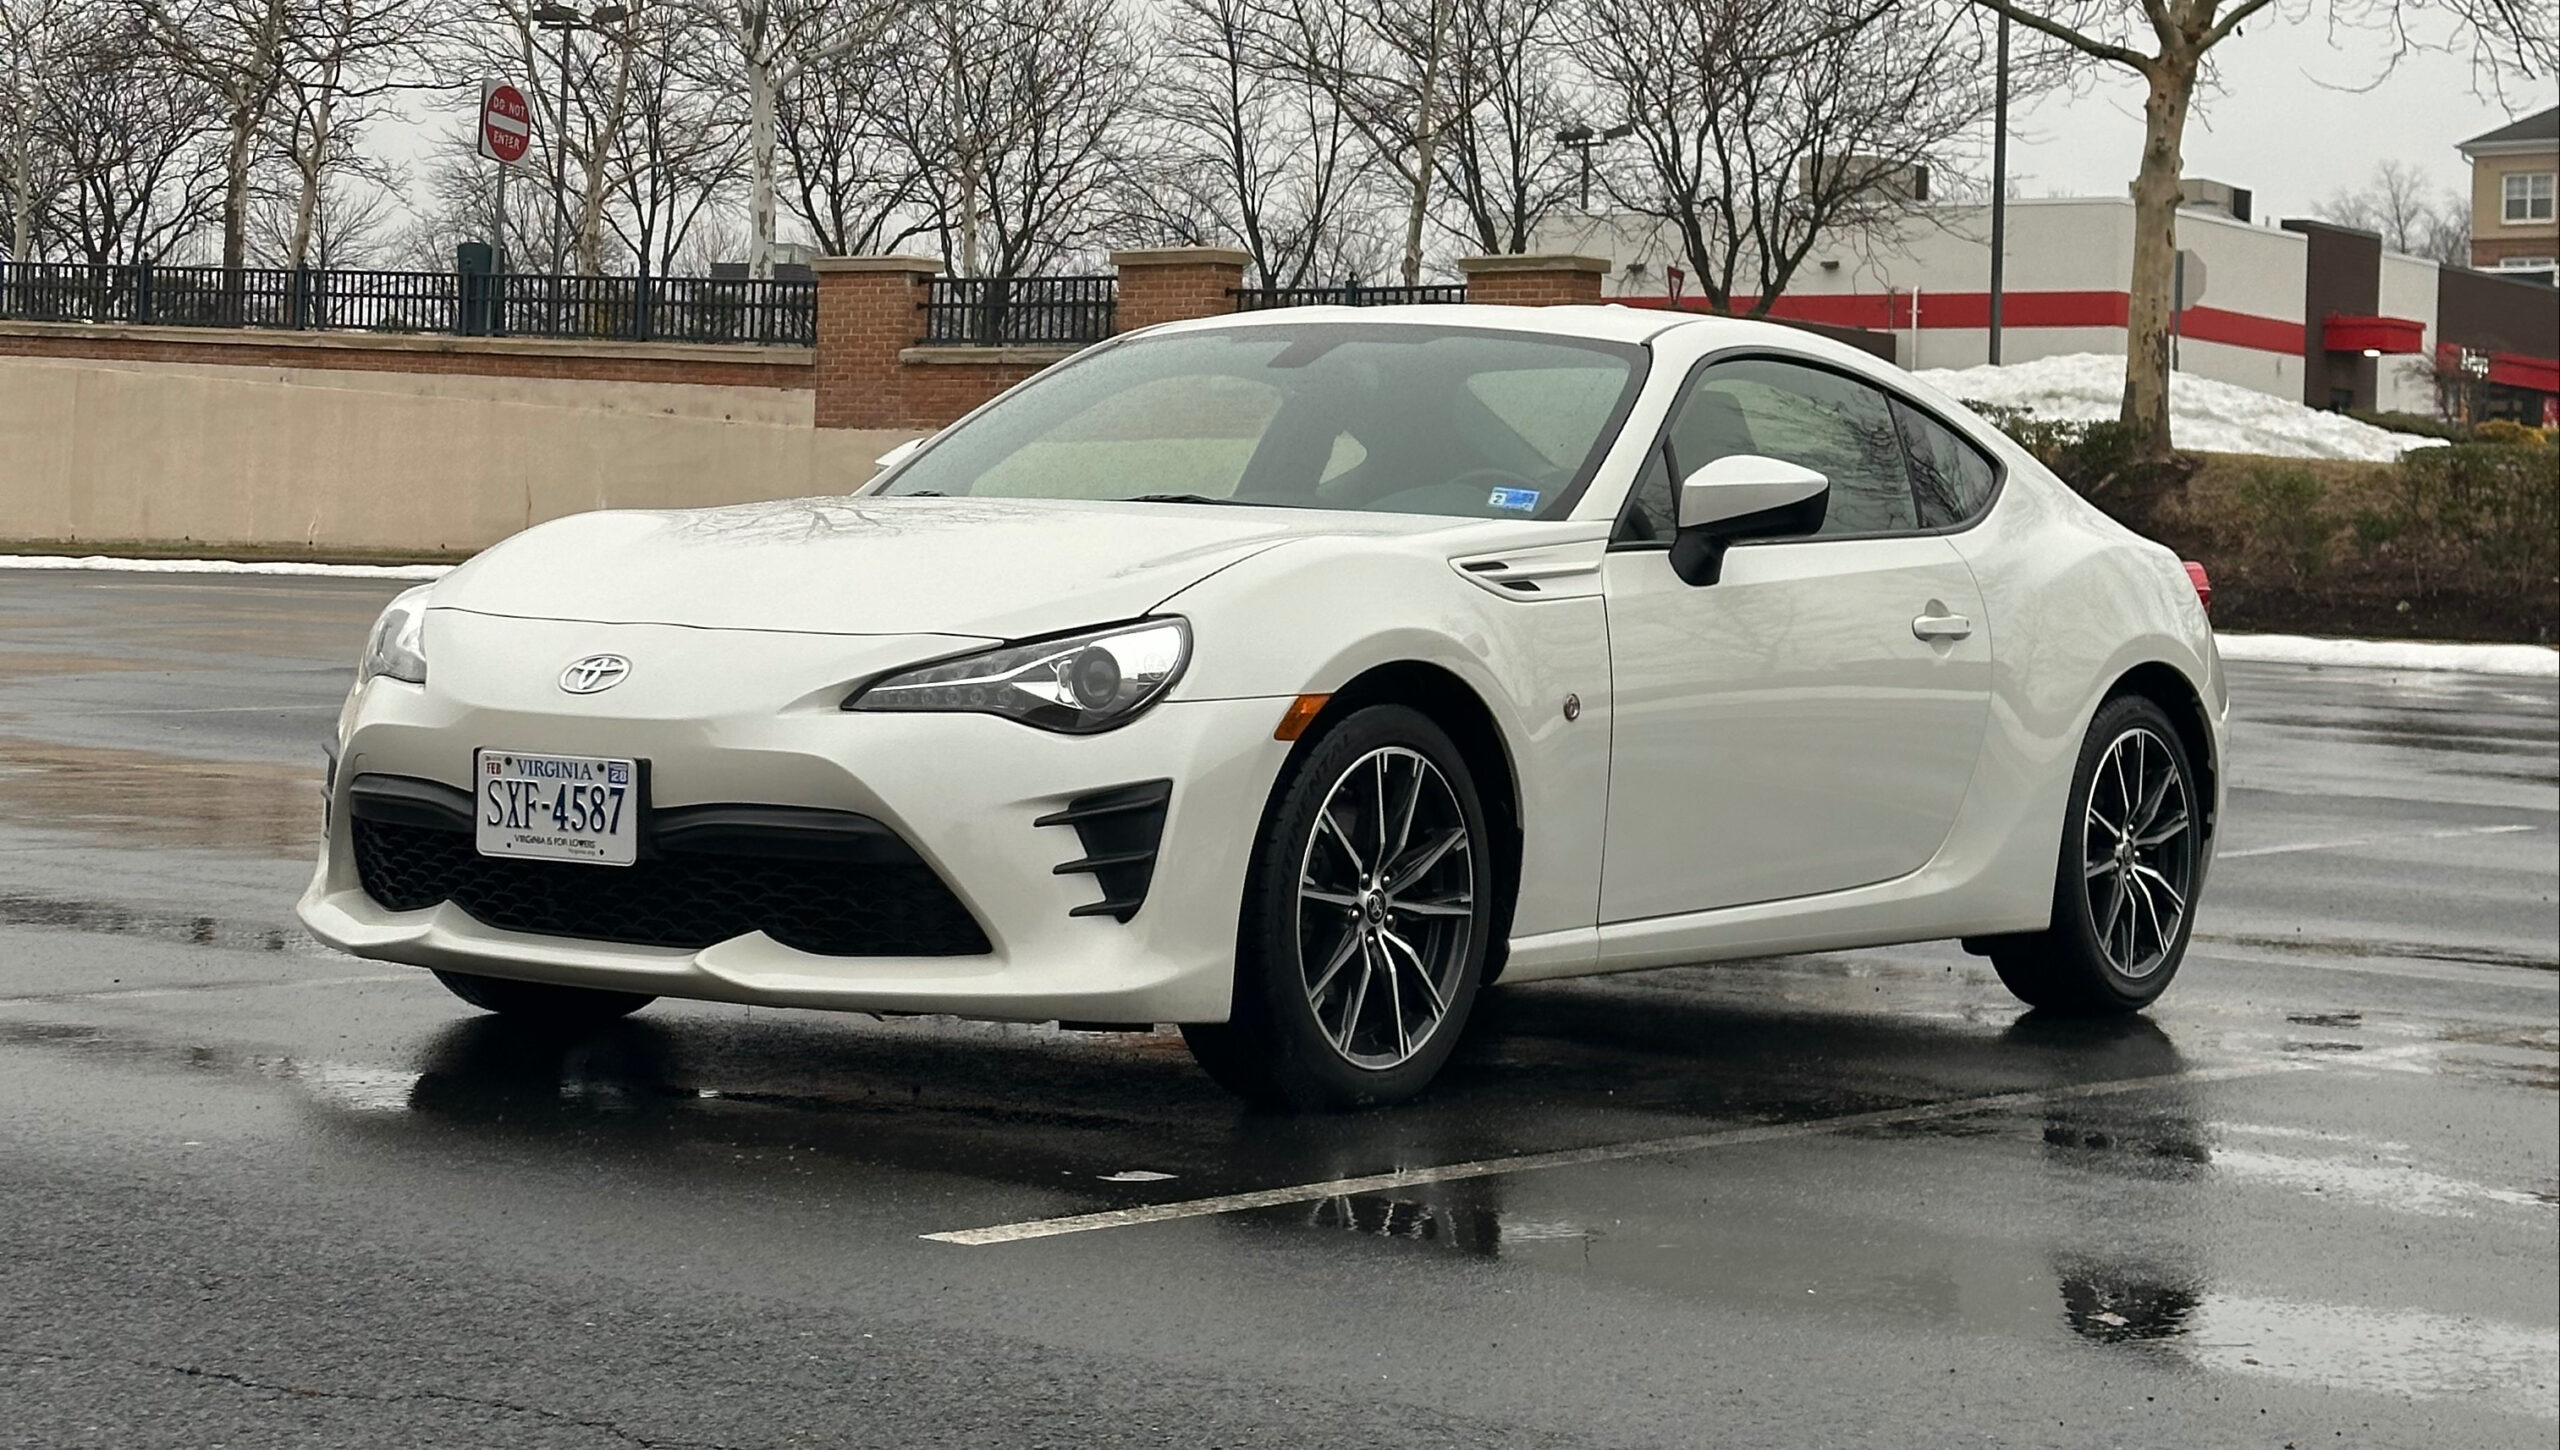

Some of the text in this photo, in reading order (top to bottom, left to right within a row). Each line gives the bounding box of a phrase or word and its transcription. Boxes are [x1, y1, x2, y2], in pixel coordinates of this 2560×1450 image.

[493, 96, 525, 117] DO NOT
[493, 130, 520, 151] ENTER
[1493, 495, 1502, 504] 2
[486, 762, 502, 775] FEB
[517, 759, 593, 780] VIRGINIA
[487, 780, 625, 835] SXF-4587
[514, 834, 545, 845] VIRGINIA
[546, 836, 553, 846] IS
[554, 837, 568, 847] FOR
